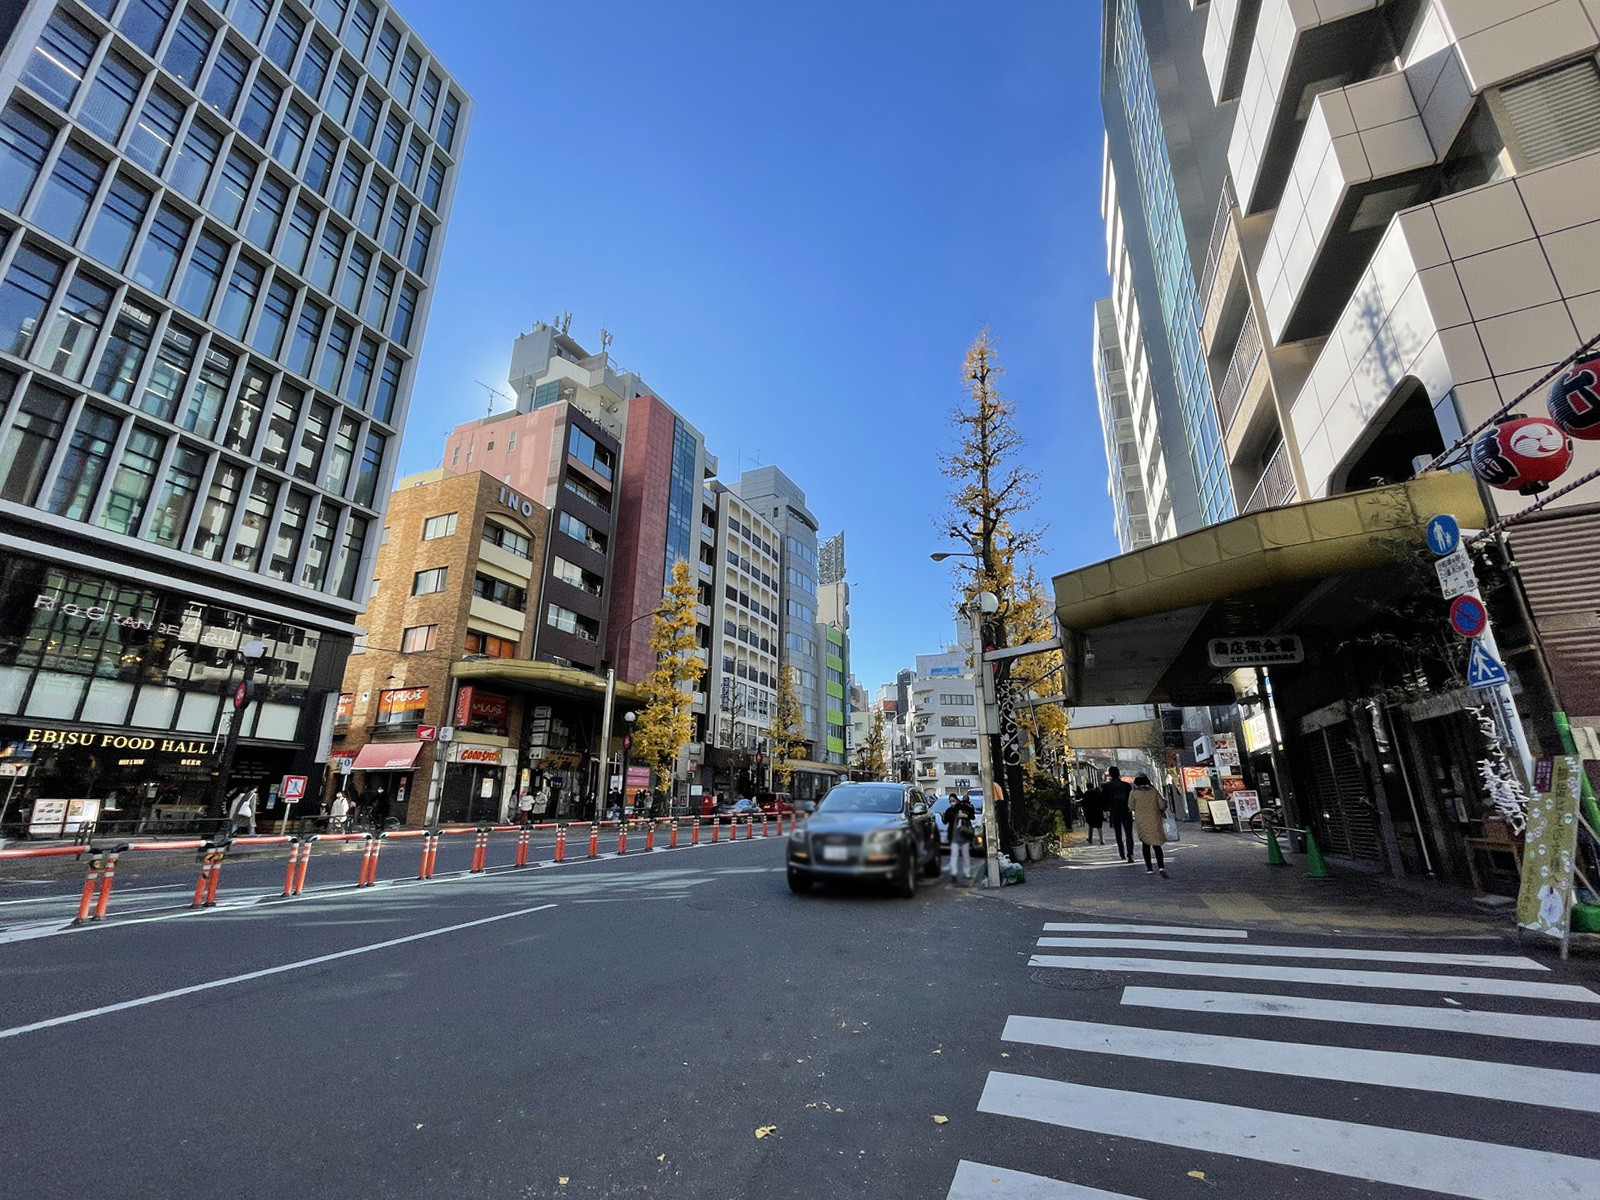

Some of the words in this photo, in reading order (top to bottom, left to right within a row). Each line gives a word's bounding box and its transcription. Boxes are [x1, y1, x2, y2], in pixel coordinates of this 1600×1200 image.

[498, 486, 534, 518] INO
[26, 729, 96, 746] EBISU
[101, 735, 155, 751] FOOD
[161, 739, 209, 755] HALL
